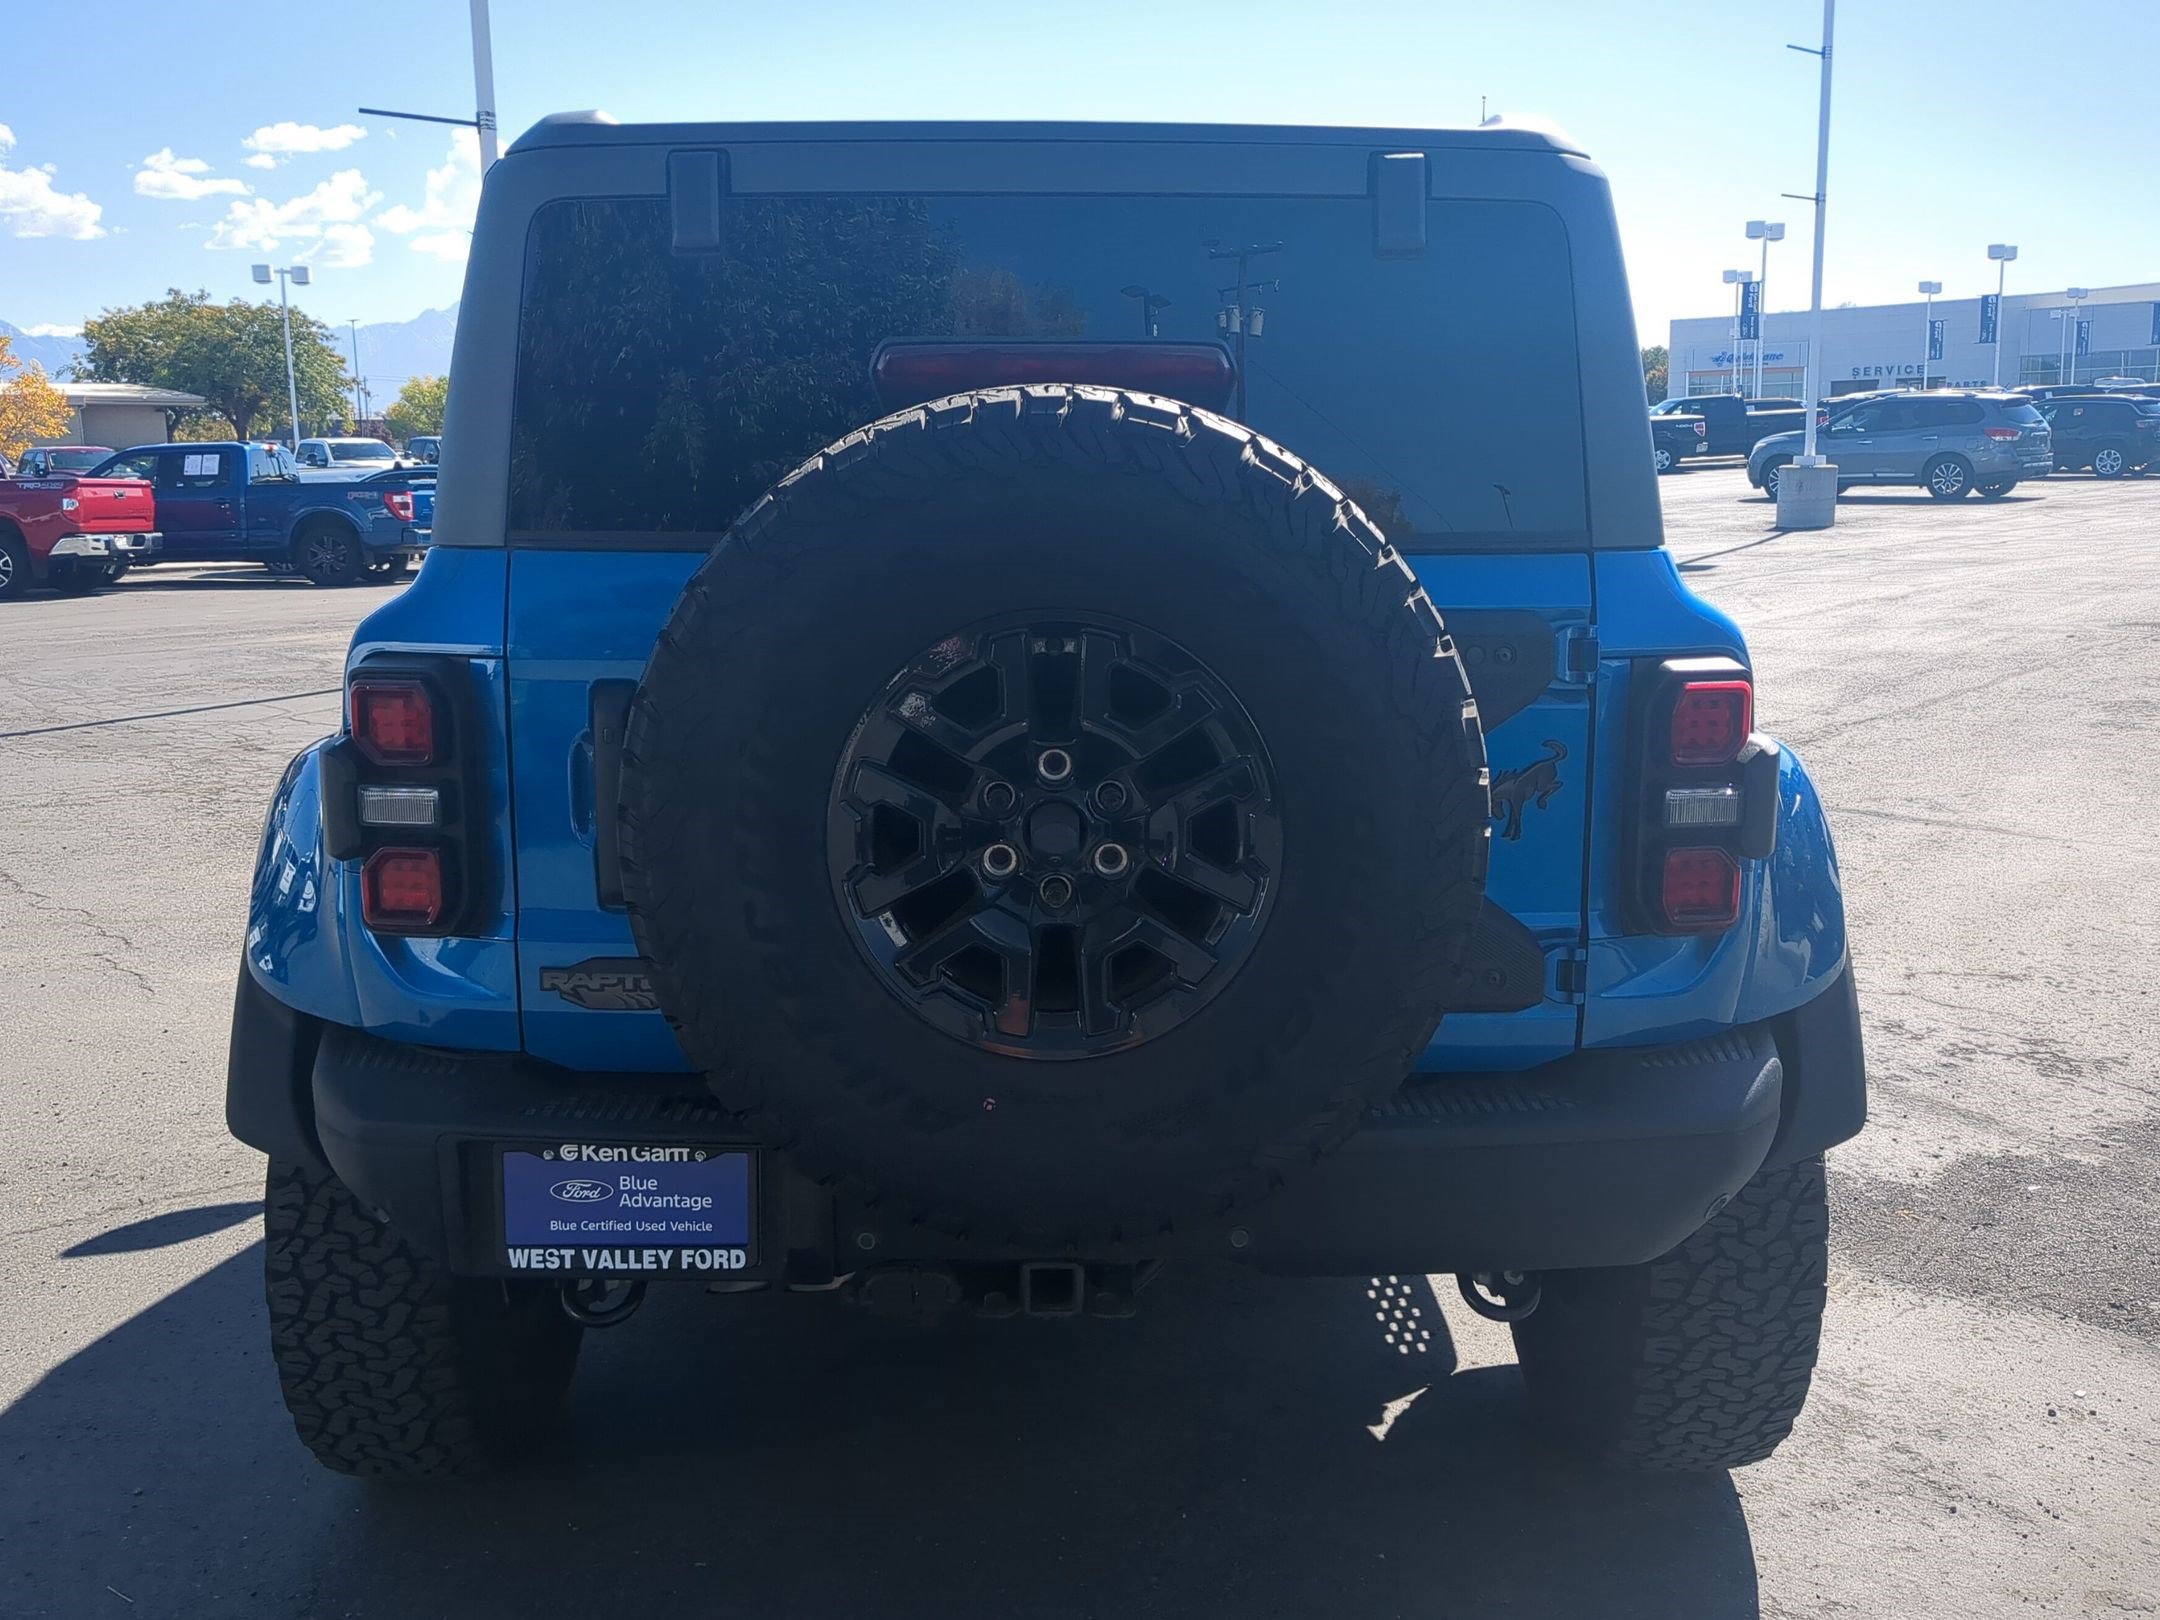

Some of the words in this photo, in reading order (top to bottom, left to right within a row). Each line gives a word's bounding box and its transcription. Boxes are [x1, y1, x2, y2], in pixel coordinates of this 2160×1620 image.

[1852, 364, 1925, 377] SERVICE
[1946, 380, 1987, 388] PARTS
[582, 1145, 628, 1162] Ken
[619, 1175, 658, 1190] Blue
[562, 1182, 602, 1200] Ford
[619, 1193, 713, 1211] Advantage
[550, 1220, 577, 1231] Blue
[580, 1220, 632, 1232] Certified
[635, 1220, 666, 1232] Used
[670, 1221, 713, 1232] Vehicle
[507, 1248, 575, 1269] WEST
[582, 1249, 674, 1270] VALLEY
[681, 1249, 747, 1270] FORD
